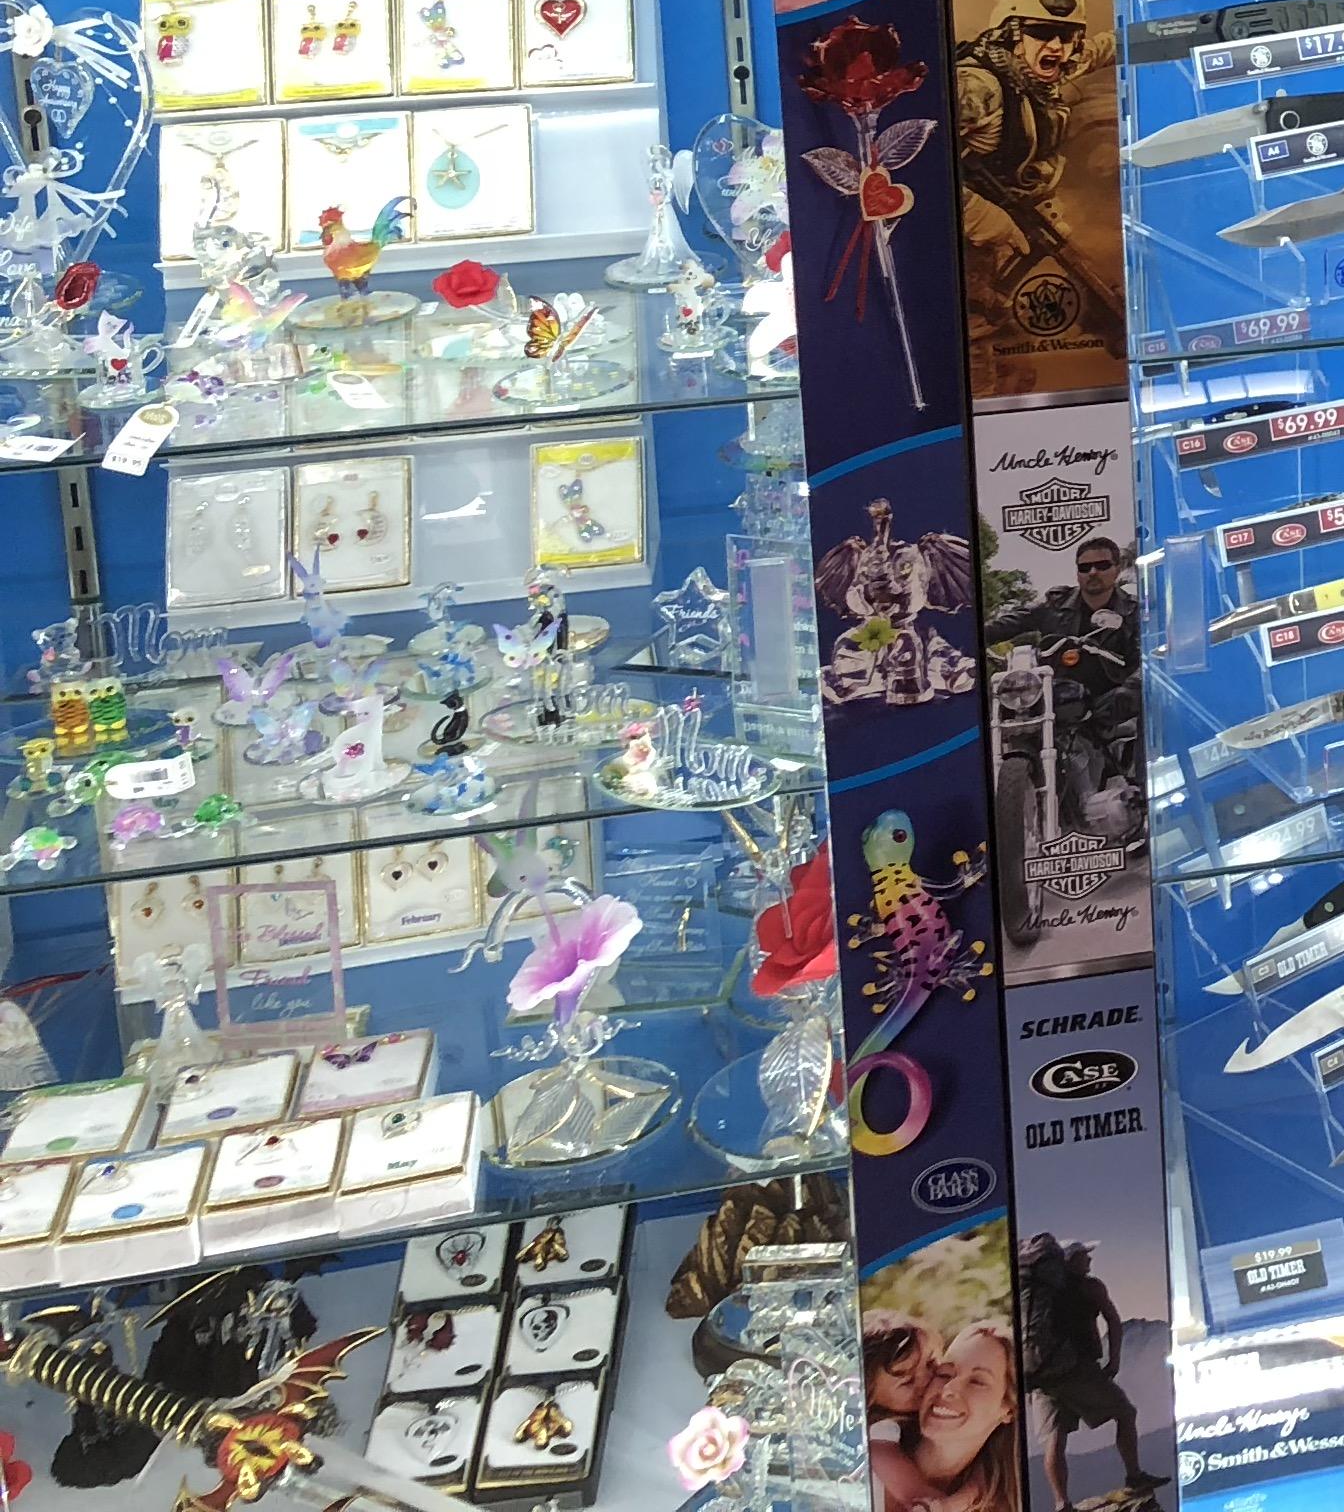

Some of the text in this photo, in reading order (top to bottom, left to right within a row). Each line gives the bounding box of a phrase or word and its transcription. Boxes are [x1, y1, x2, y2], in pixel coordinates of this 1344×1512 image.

[1241, 313, 1300, 338] $69.99
[1181, 408, 1338, 450] C16 $69.99
[990, 445, 1116, 474] Uncle Henry
[1031, 488, 1080, 503] MOTOR
[1010, 502, 1103, 525] HARLEY-DAVIDSON
[1031, 524, 1082, 543] CYCLES
[1229, 534, 1249, 545] C17
[661, 603, 719, 619] Friends
[1275, 630, 1296, 642] C18
[1050, 838, 1100, 855] MOTOR
[1030, 852, 1119, 876] HARLEY-DAVIDSON
[1051, 874, 1099, 894] CYCLES
[401, 912, 442, 926] February
[1019, 904, 1136, 932] Uncle Henry
[1020, 1005, 1139, 1039] SCHRADE
[1026, 1107, 1143, 1150] OLD TIMER
[1255, 1246, 1292, 1262] $19.99
[1247, 1259, 1306, 1285] OLD TIMER
